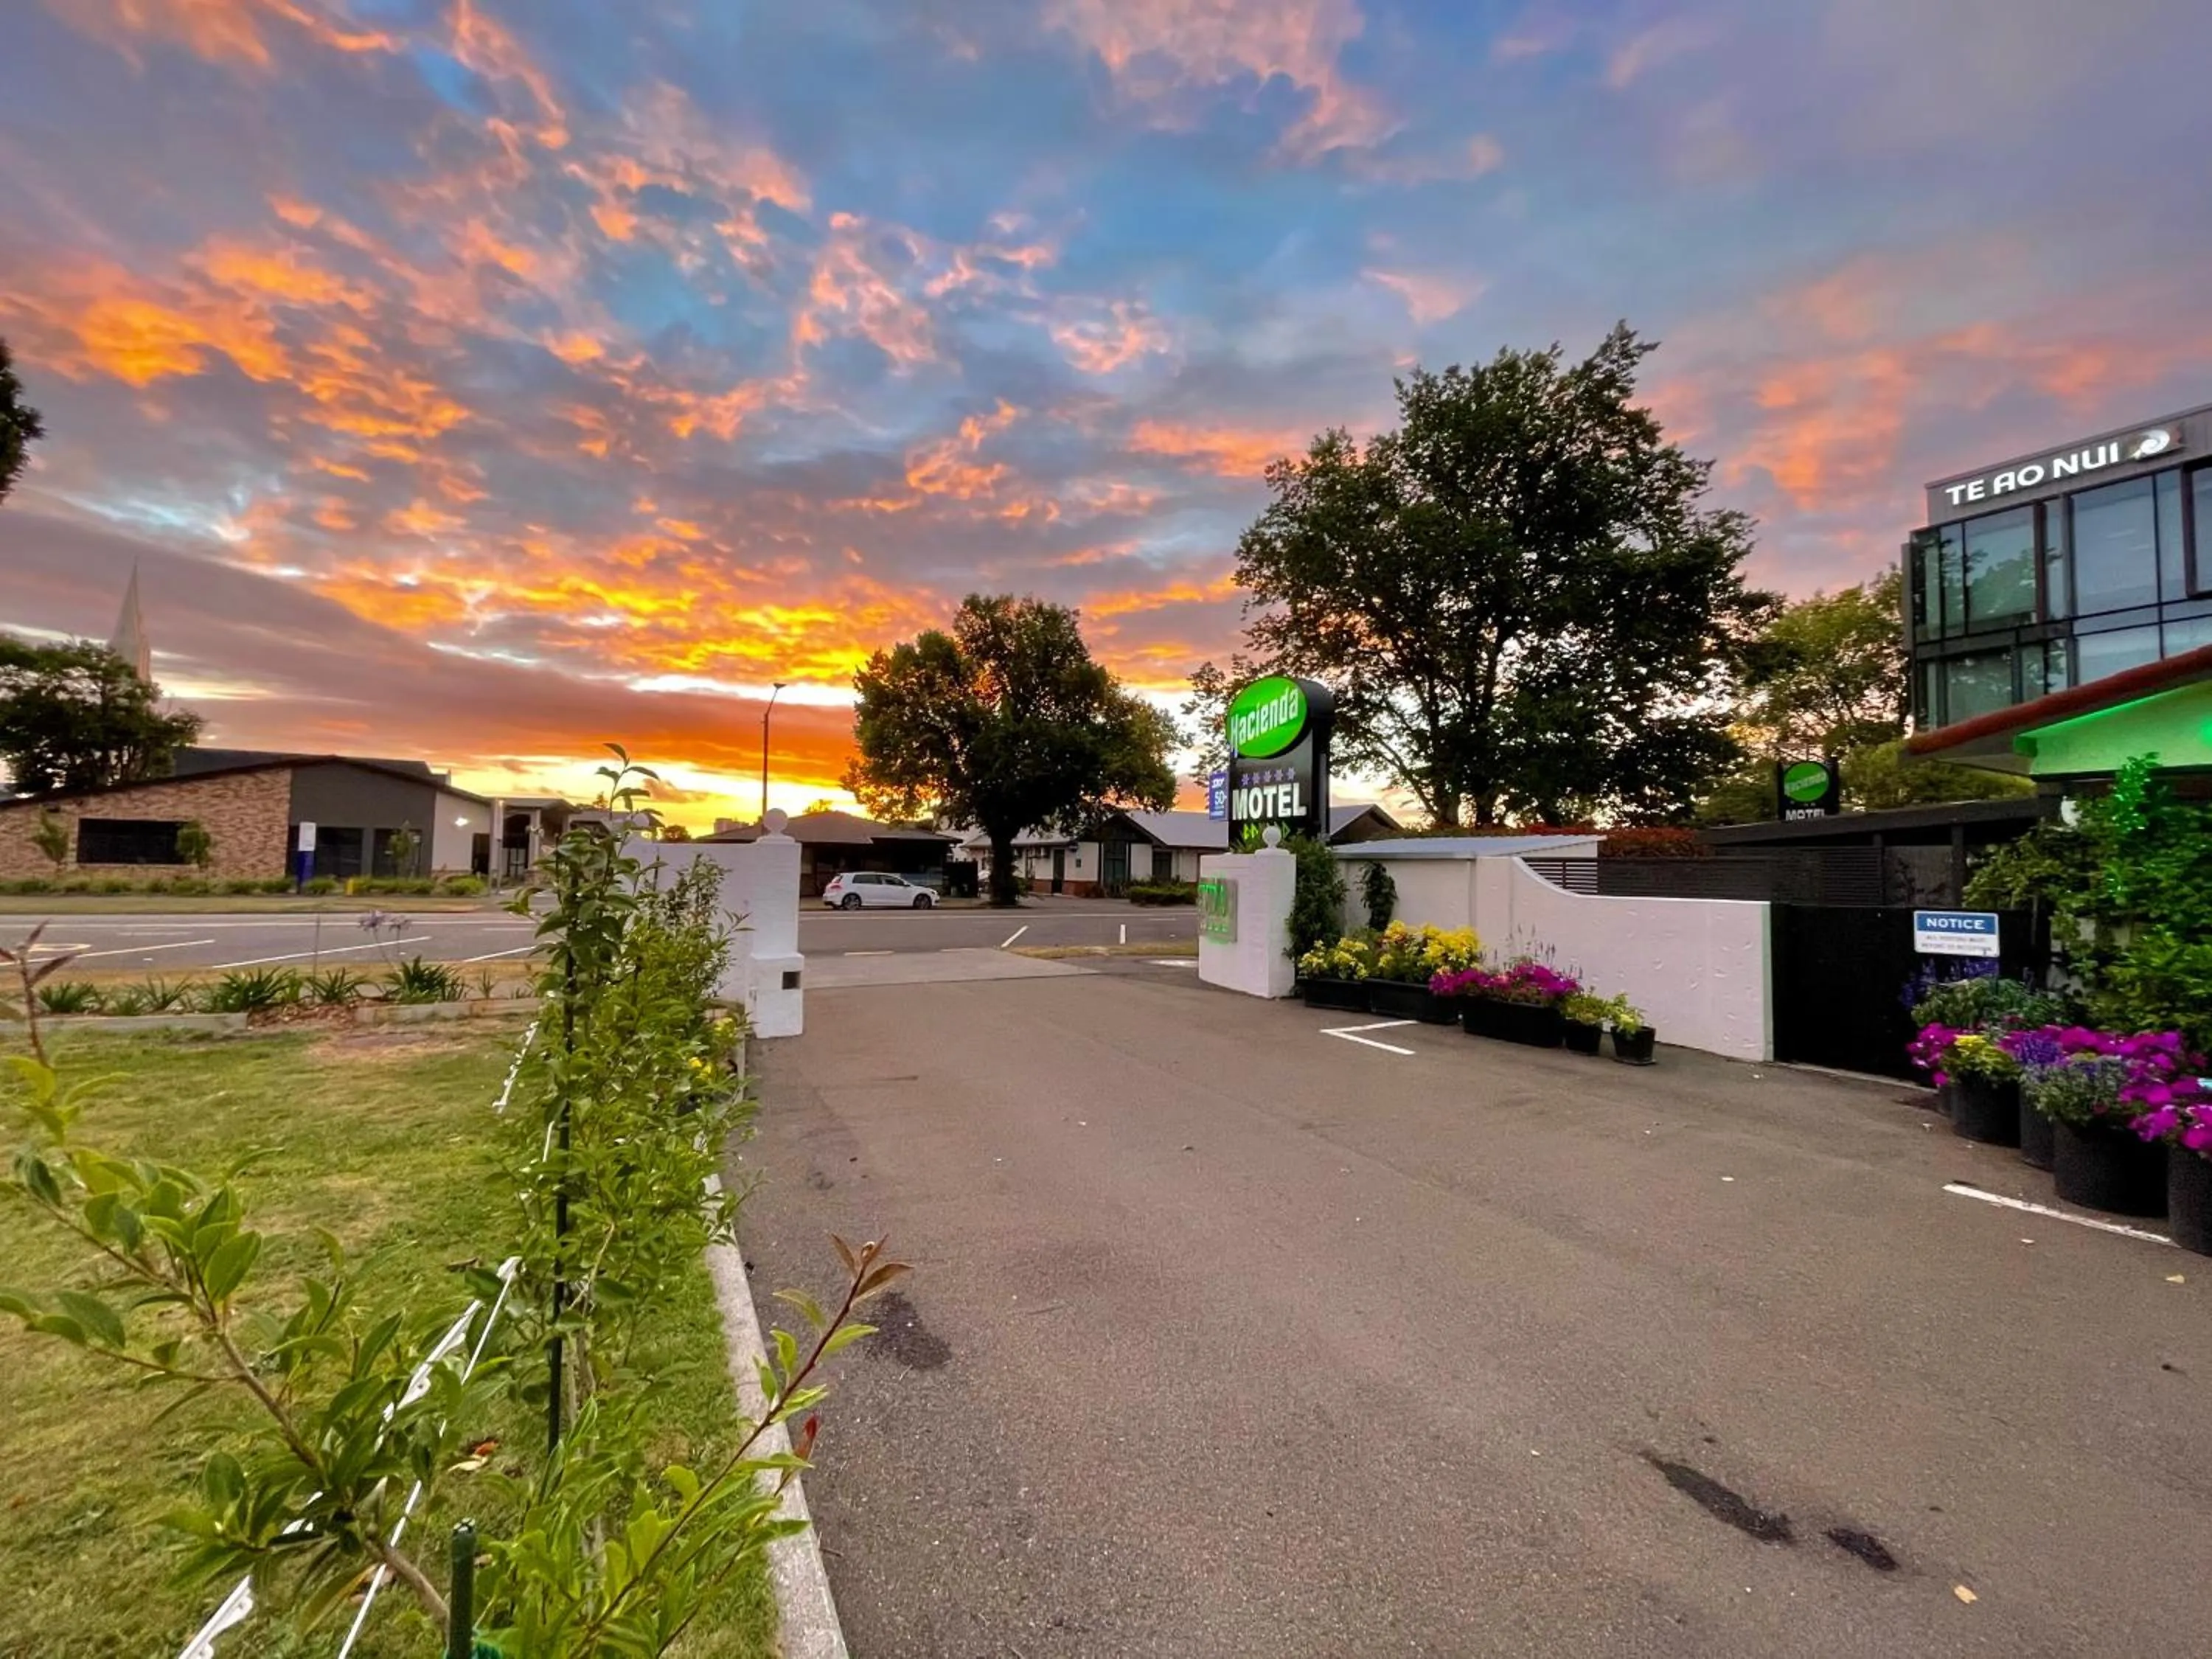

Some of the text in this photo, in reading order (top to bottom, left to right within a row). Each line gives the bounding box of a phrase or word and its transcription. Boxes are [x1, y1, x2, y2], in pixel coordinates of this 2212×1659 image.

[1945, 442, 2119, 505] TE AO NUI
[1231, 685, 1298, 758] Hacienda
[1232, 782, 1307, 820] MOTEL
[1926, 918, 1986, 930] NOTICE
